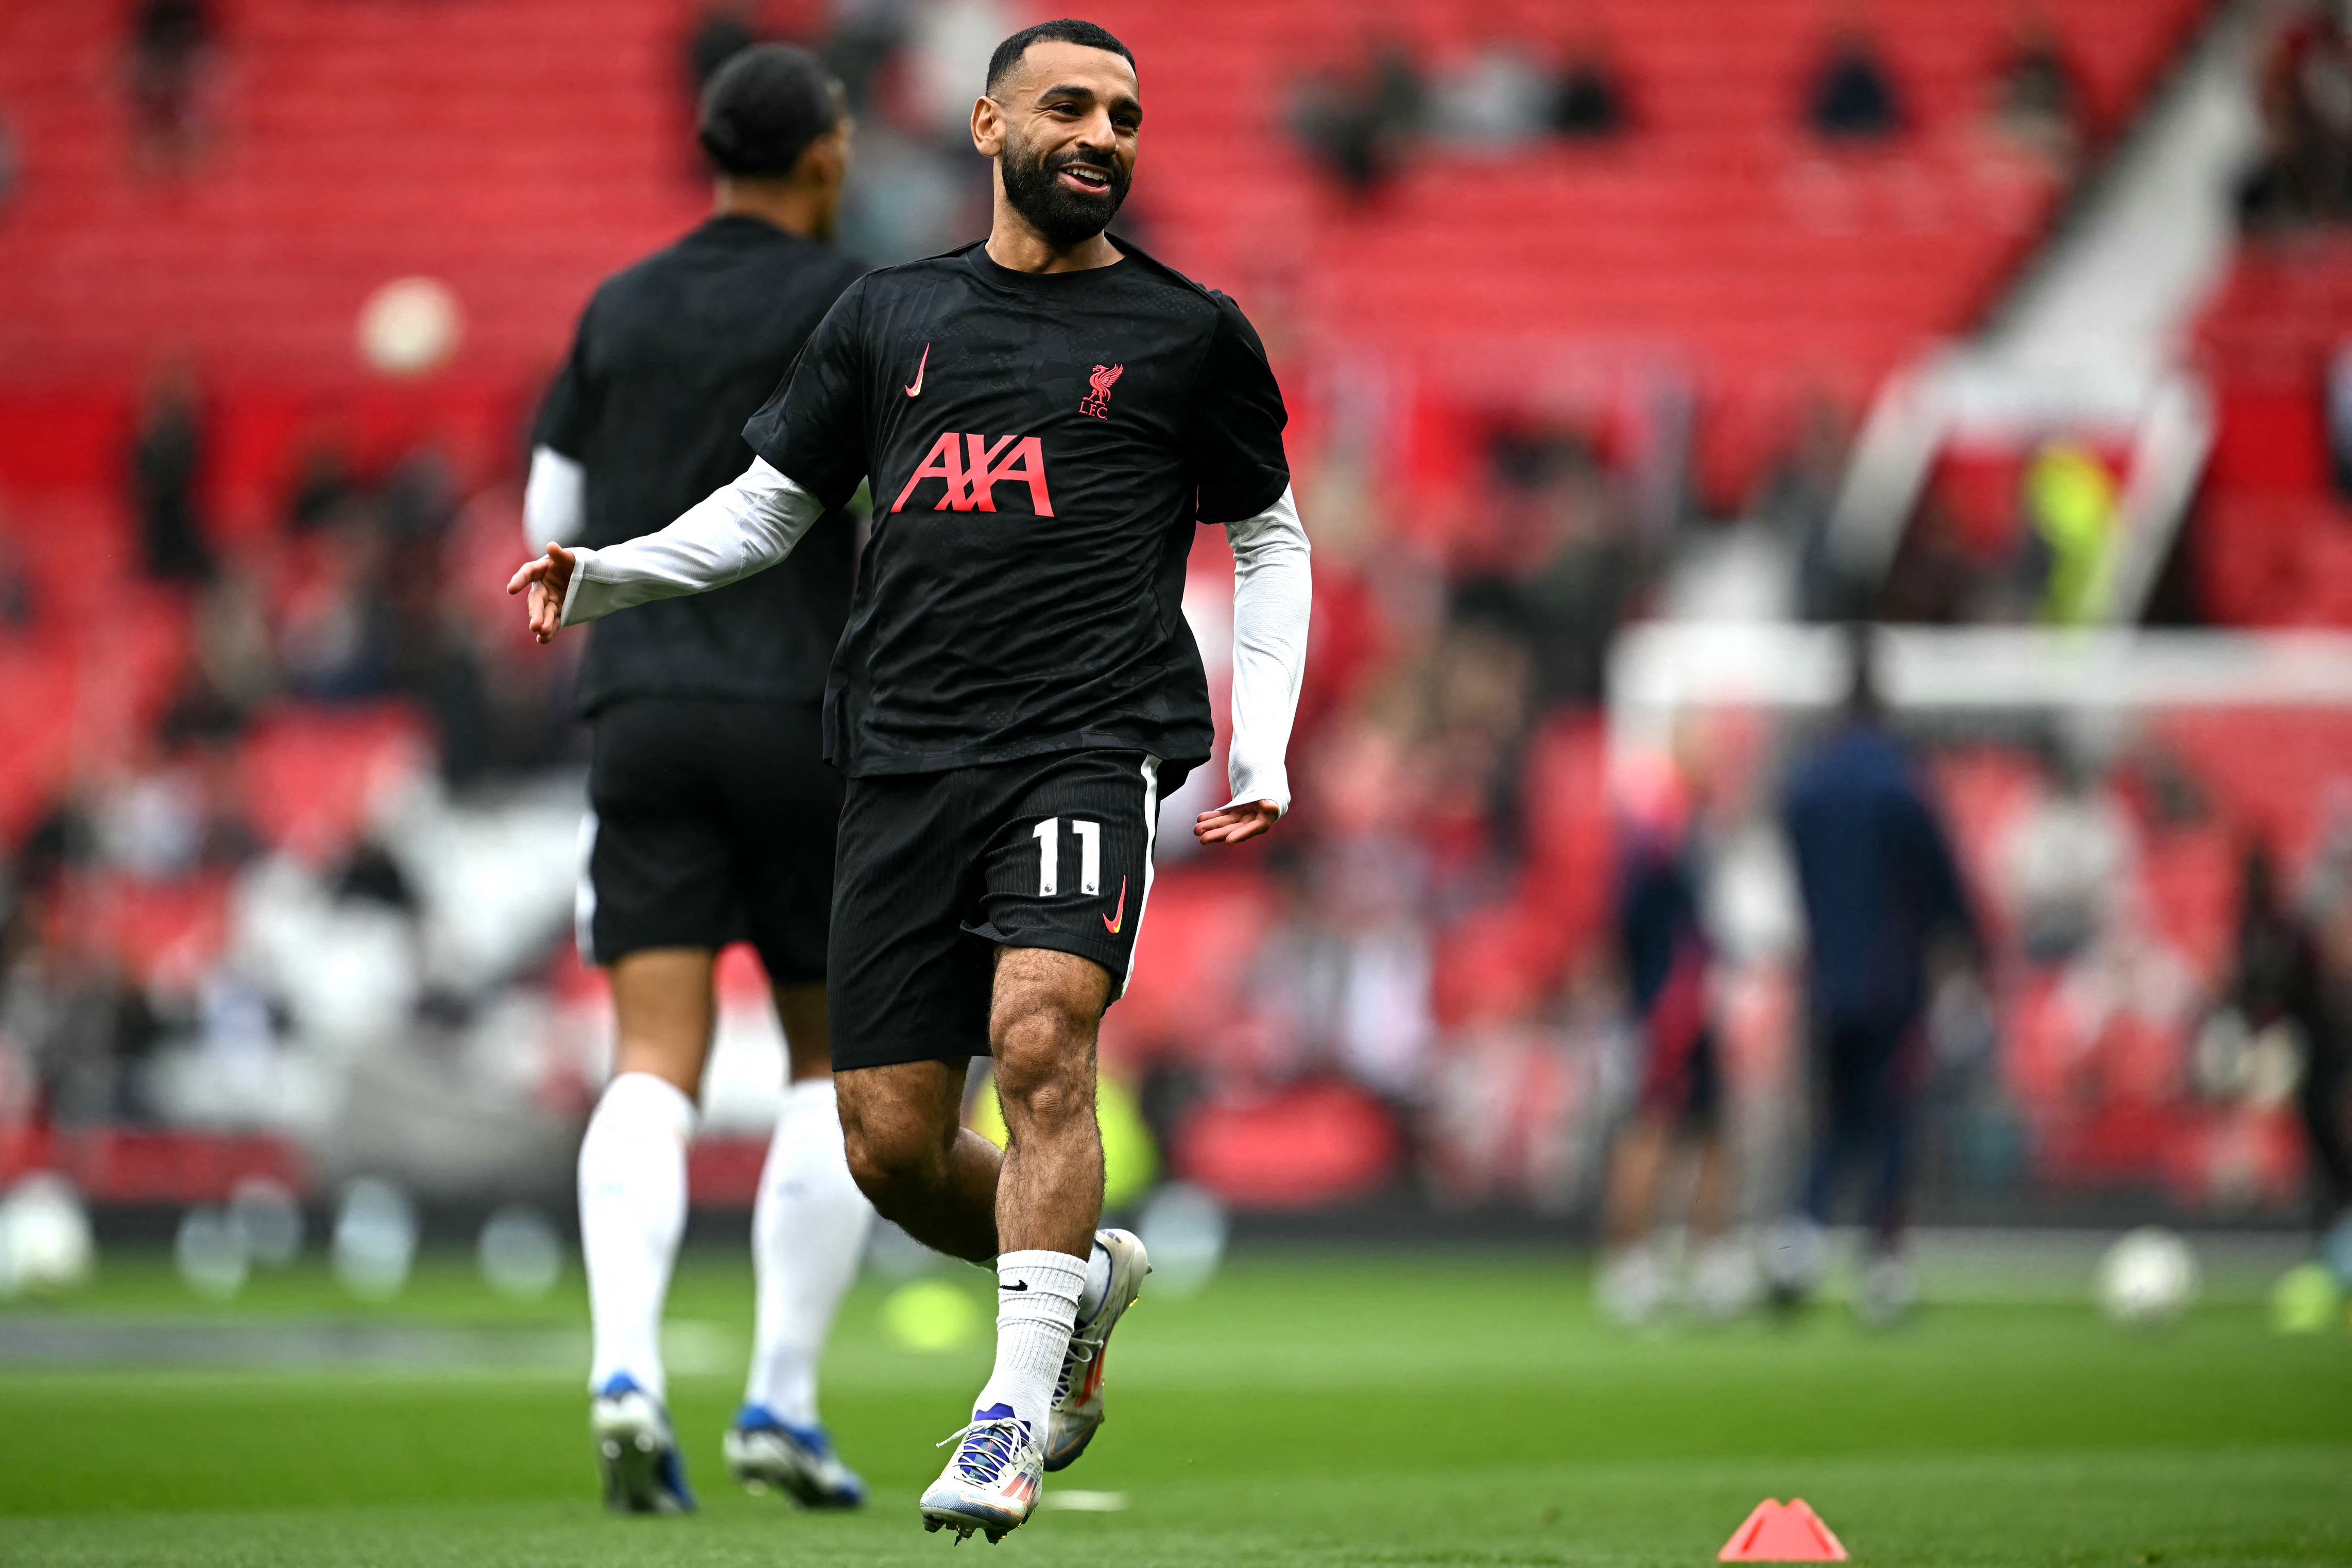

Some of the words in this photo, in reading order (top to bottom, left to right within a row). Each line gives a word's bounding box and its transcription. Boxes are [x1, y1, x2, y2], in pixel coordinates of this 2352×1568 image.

[1078, 401, 1108, 420] L.F.C.
[890, 432, 1055, 518] AXA
[1032, 817, 1100, 897] 11
